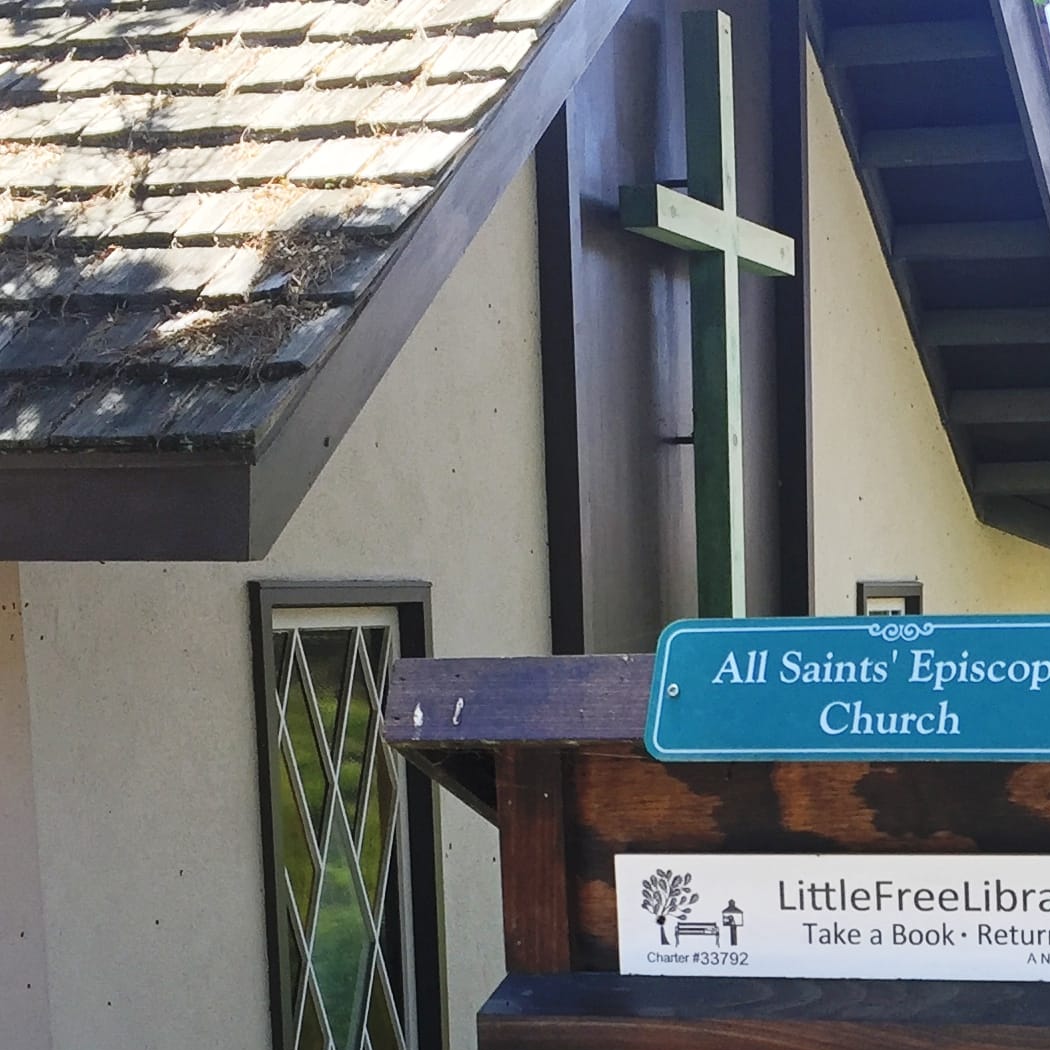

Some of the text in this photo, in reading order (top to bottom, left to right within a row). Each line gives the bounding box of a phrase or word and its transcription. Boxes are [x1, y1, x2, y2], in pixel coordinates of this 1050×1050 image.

[712, 650, 767, 684] All
[780, 650, 898, 684] Saints'
[819, 700, 960, 735] Church
[803, 922, 864, 947] Take
[870, 928, 885, 946] a
[646, 951, 749, 965] Charter #33792
[1027, 953, 1037, 965] A
